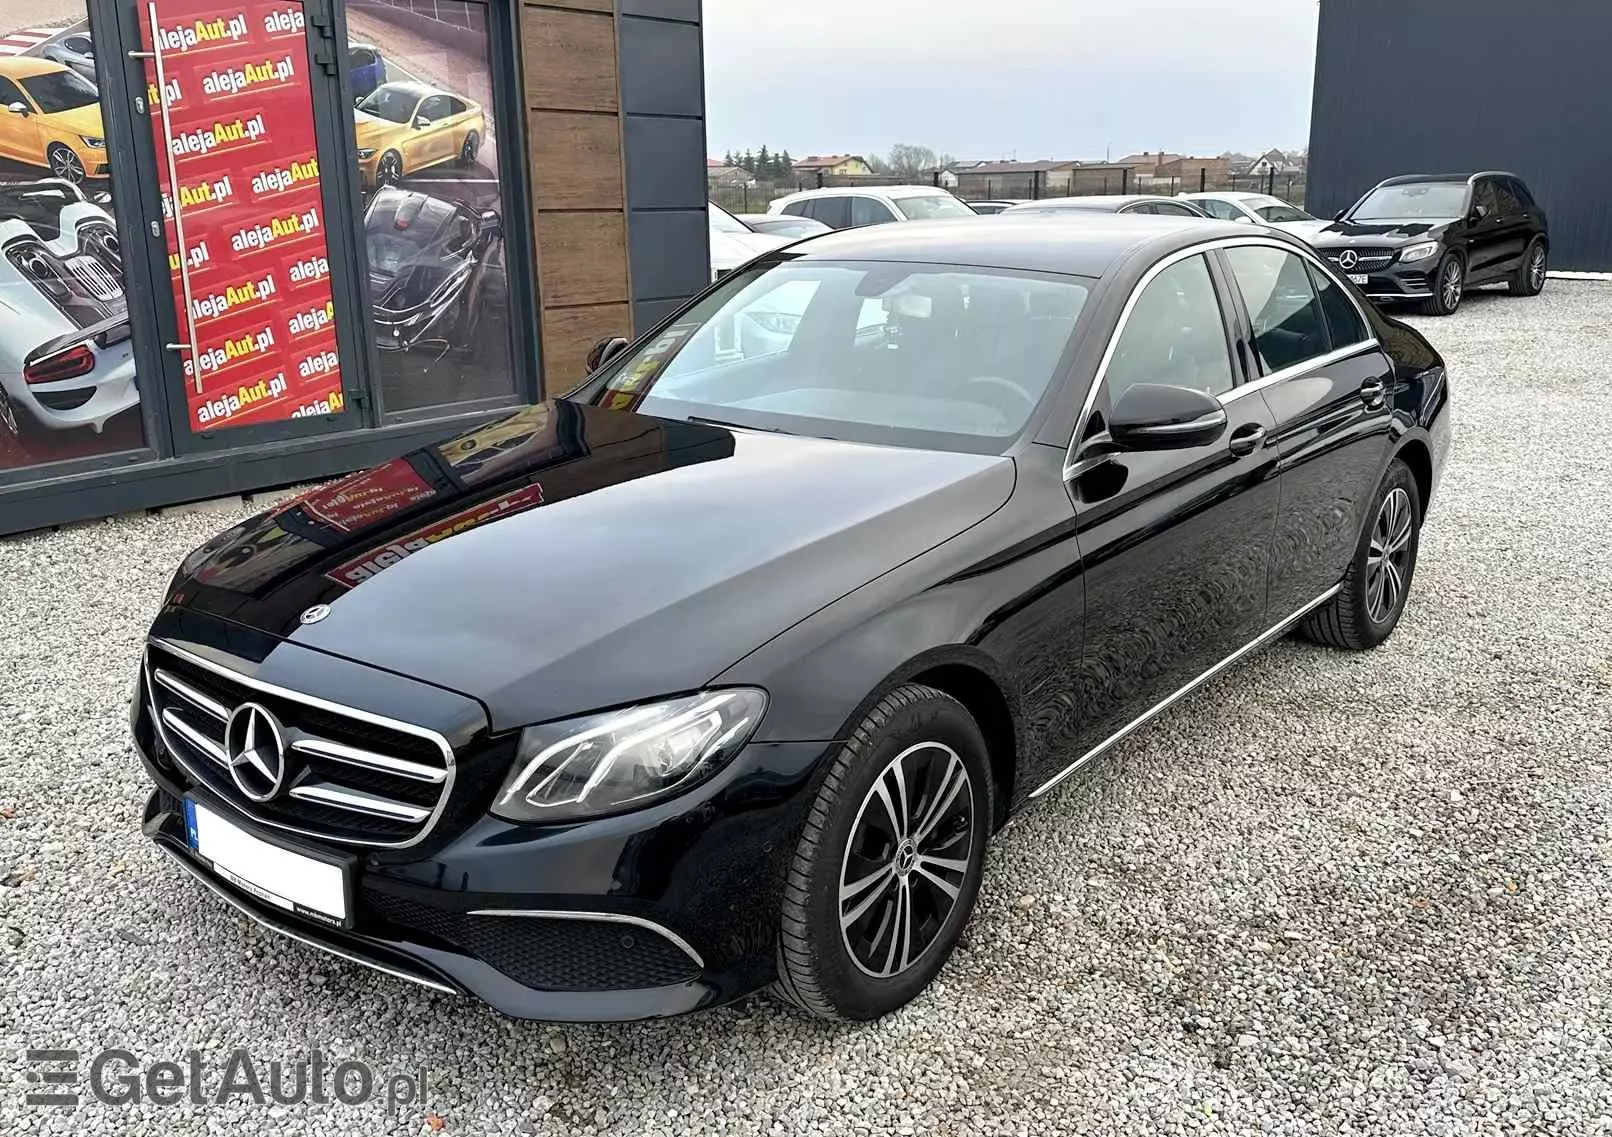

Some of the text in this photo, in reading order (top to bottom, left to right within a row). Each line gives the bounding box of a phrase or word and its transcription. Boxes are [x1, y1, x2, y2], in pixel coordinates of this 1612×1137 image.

[203, 56, 295, 94] alejaAut.pl
[171, 115, 266, 153] alejaAut.pl
[231, 208, 319, 251] alejaAut.pl
[184, 327, 275, 376] aejaAut.pl
[197, 373, 287, 423] alejaAut.pl
